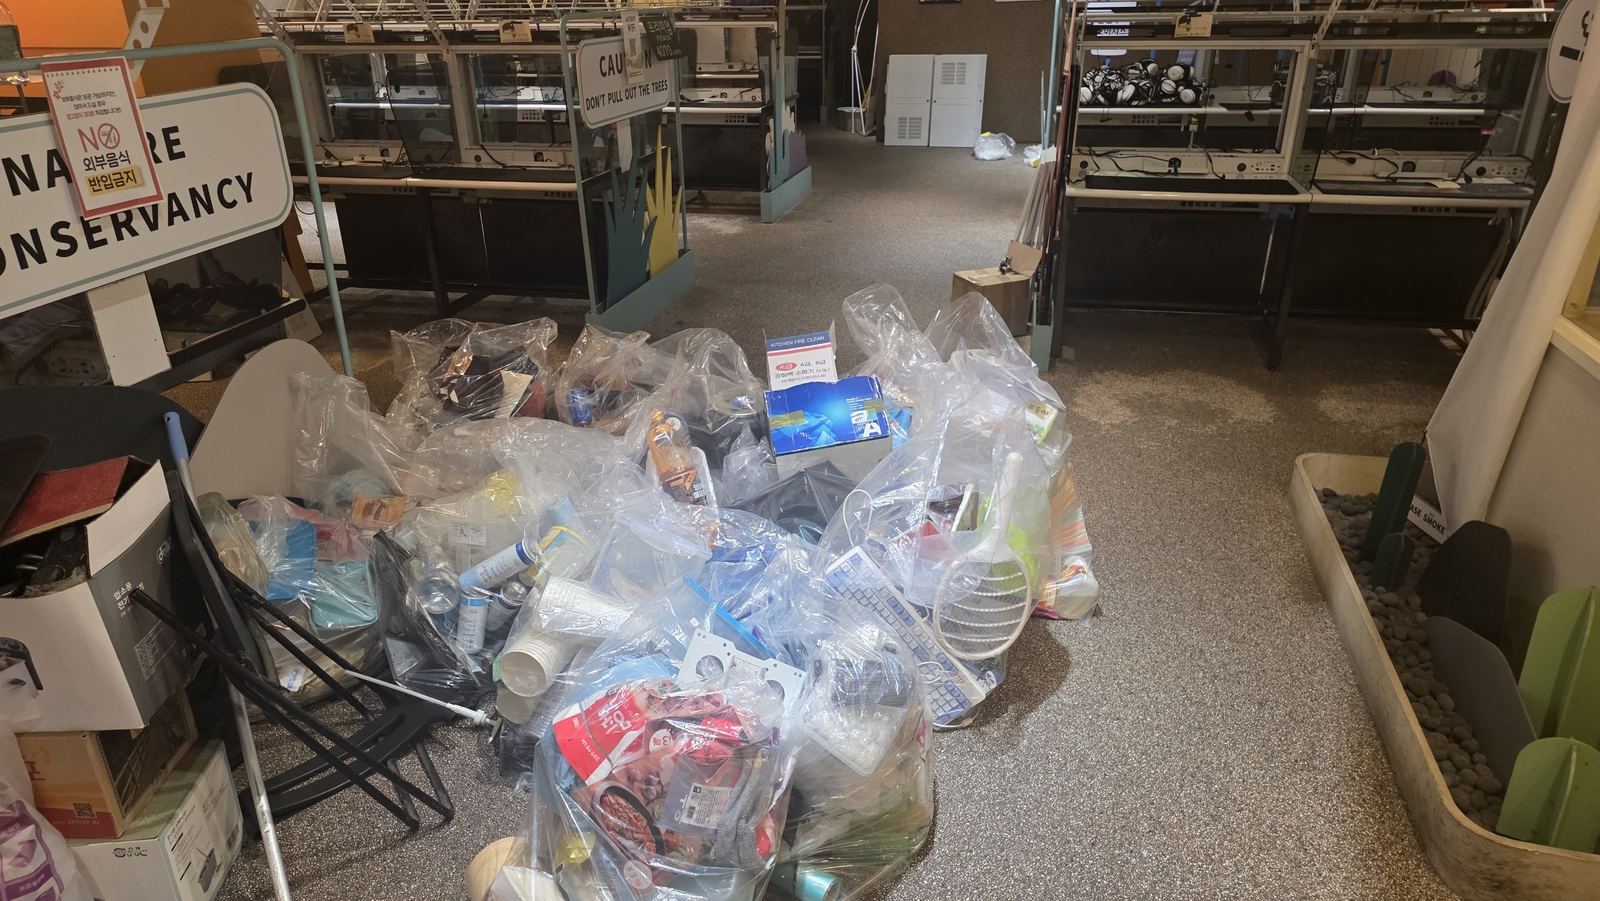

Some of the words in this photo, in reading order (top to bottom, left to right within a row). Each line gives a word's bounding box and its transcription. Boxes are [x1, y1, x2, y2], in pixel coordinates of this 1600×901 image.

[599, 49, 652, 78] CAUN
[585, 95, 605, 111] DON'T
[608, 92, 623, 105] PULL
[625, 87, 637, 100] OUT
[639, 85, 650, 96] THE
[652, 80, 668, 93] TREES
[77, 123, 121, 152] NO
[1, 126, 187, 197] NARE
[83, 150, 132, 171] 외부음식
[88, 169, 137, 193] 반입금지
[0, 172, 254, 277] NSERVANCY
[806, 335, 825, 343] CLEAN
[795, 368, 815, 376] 소화기
[1423, 514, 1446, 535] SMOKE
